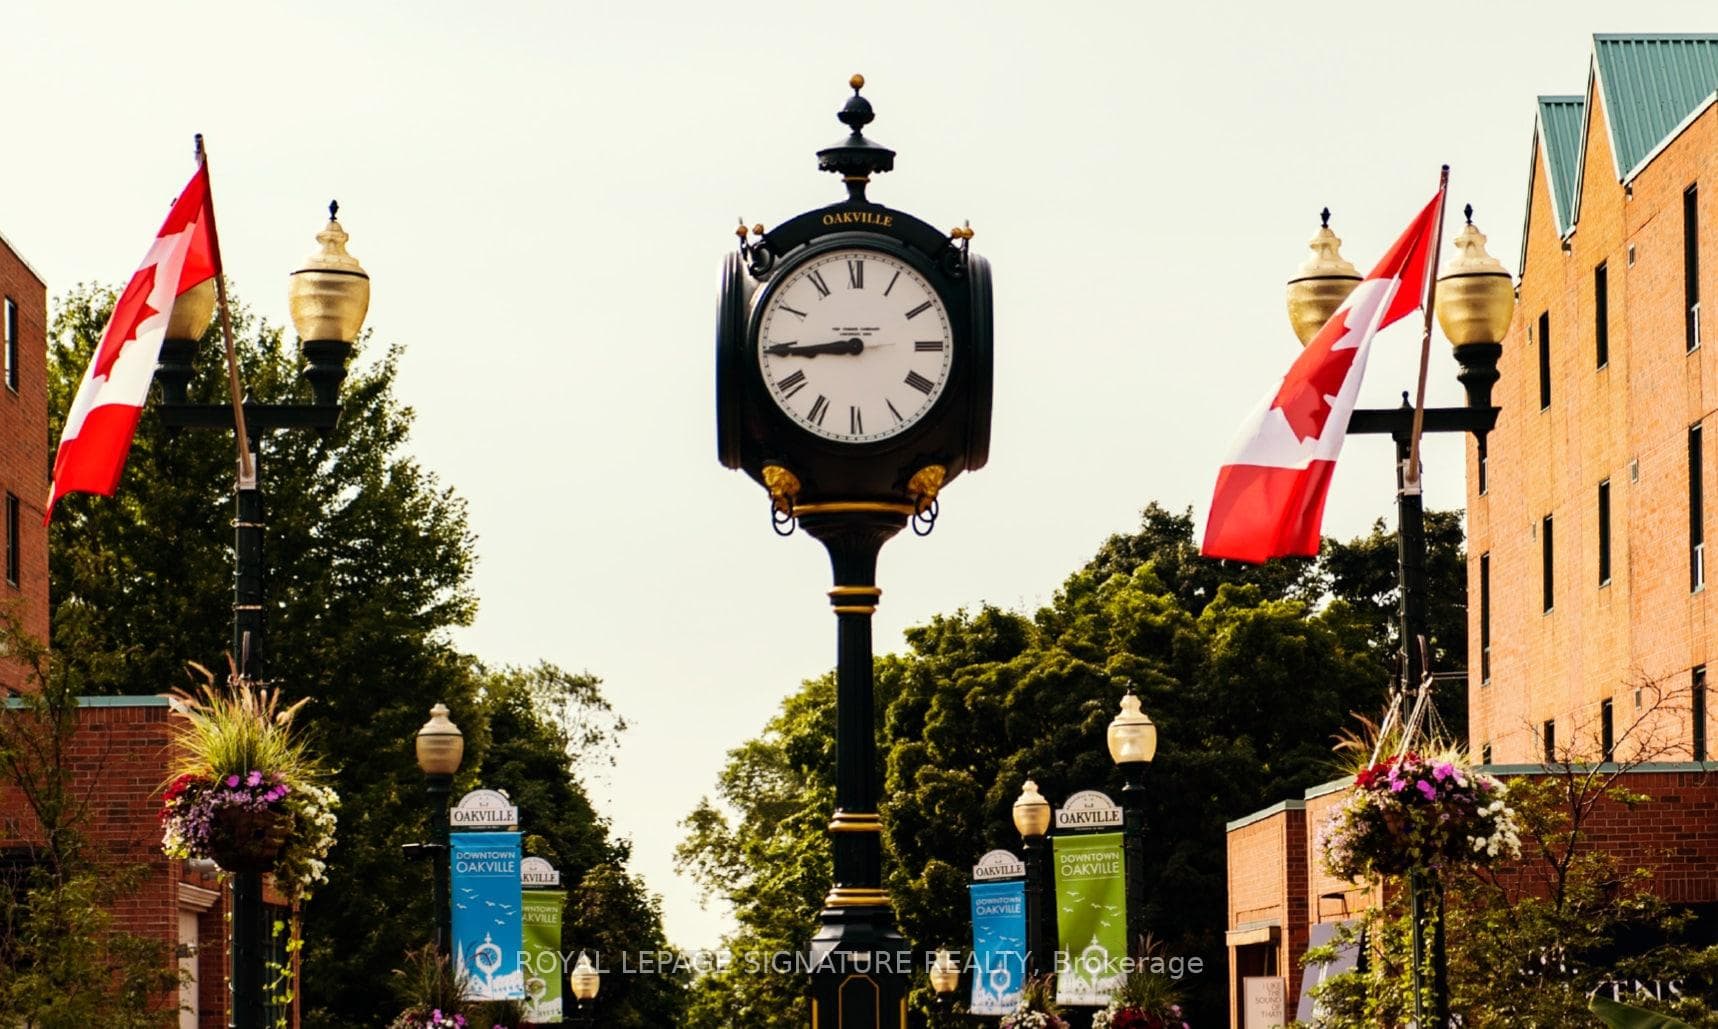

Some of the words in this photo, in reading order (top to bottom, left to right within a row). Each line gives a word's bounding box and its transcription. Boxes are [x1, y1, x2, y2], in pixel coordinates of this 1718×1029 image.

[823, 212, 893, 227] OAKVILLE
[454, 810, 514, 822] OAKVILLE
[1059, 810, 1120, 824] OAKVILLE
[456, 851, 516, 860] DOWNTOWN
[1060, 852, 1120, 863] DOWNTOWN
[456, 861, 515, 873] OAKVILLE
[975, 864, 1023, 877] OAKVILLE
[1061, 861, 1120, 877] OAKVILLE
[522, 872, 556, 883] KVILLE
[975, 897, 1022, 905] DOWNTOWN
[975, 903, 1022, 916] OAKVILLE
